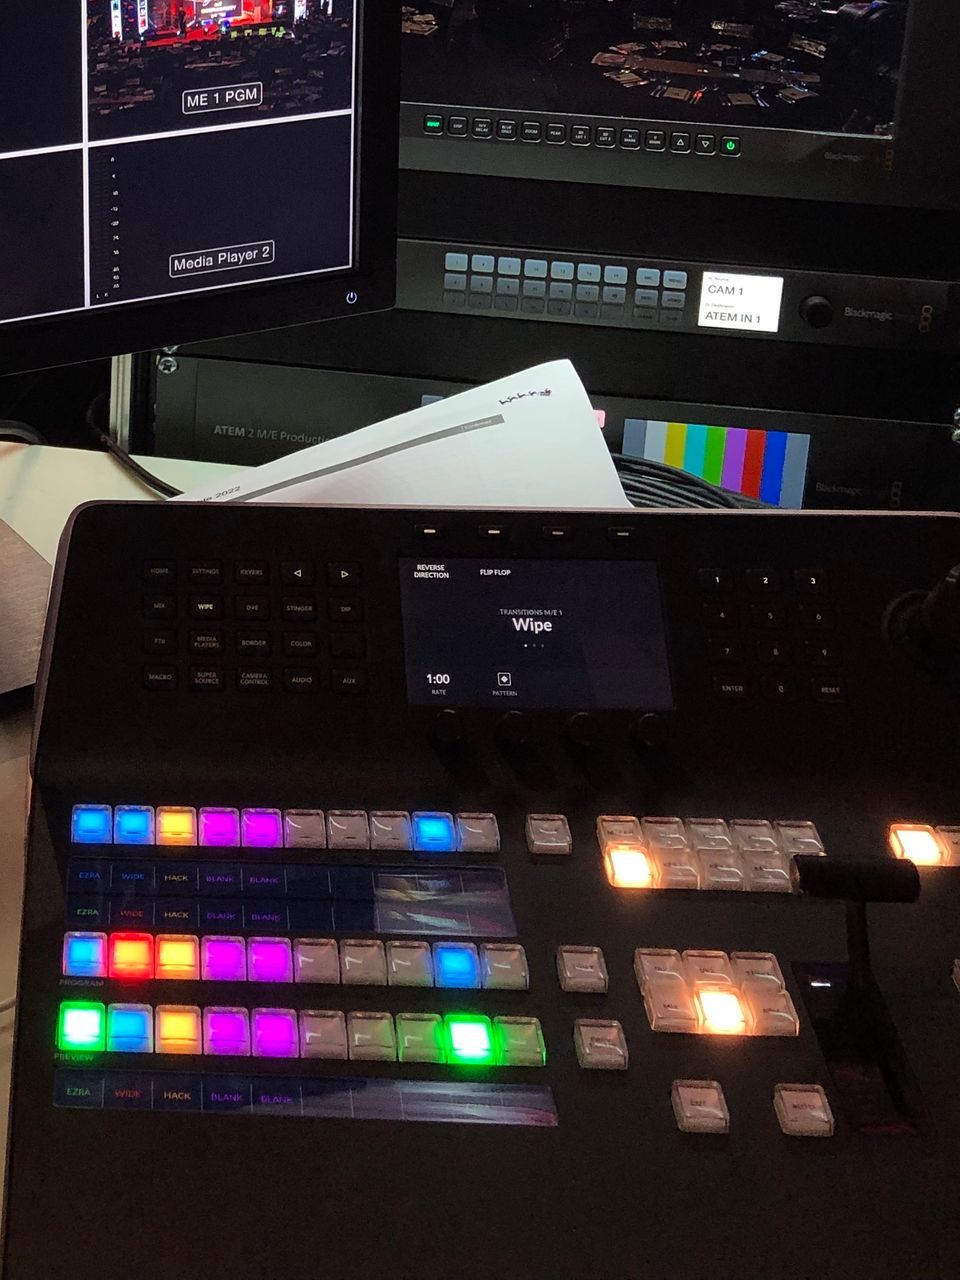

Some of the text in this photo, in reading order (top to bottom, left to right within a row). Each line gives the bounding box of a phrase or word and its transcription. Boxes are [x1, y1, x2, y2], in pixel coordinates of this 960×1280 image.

[187, 87, 258, 108] ME 1 PGM
[174, 247, 269, 271] Media Player 2
[708, 284, 744, 296] CAM 1
[705, 311, 737, 322] ATEM
[741, 314, 753, 323] IN
[213, 424, 245, 438] ATEM
[248, 428, 254, 438] 2
[216, 486, 240, 498] 2022
[512, 618, 553, 634] Wipe
[426, 674, 450, 685] 1:00
[164, 874, 188, 882] HACK
[163, 1091, 191, 1101] HACK
